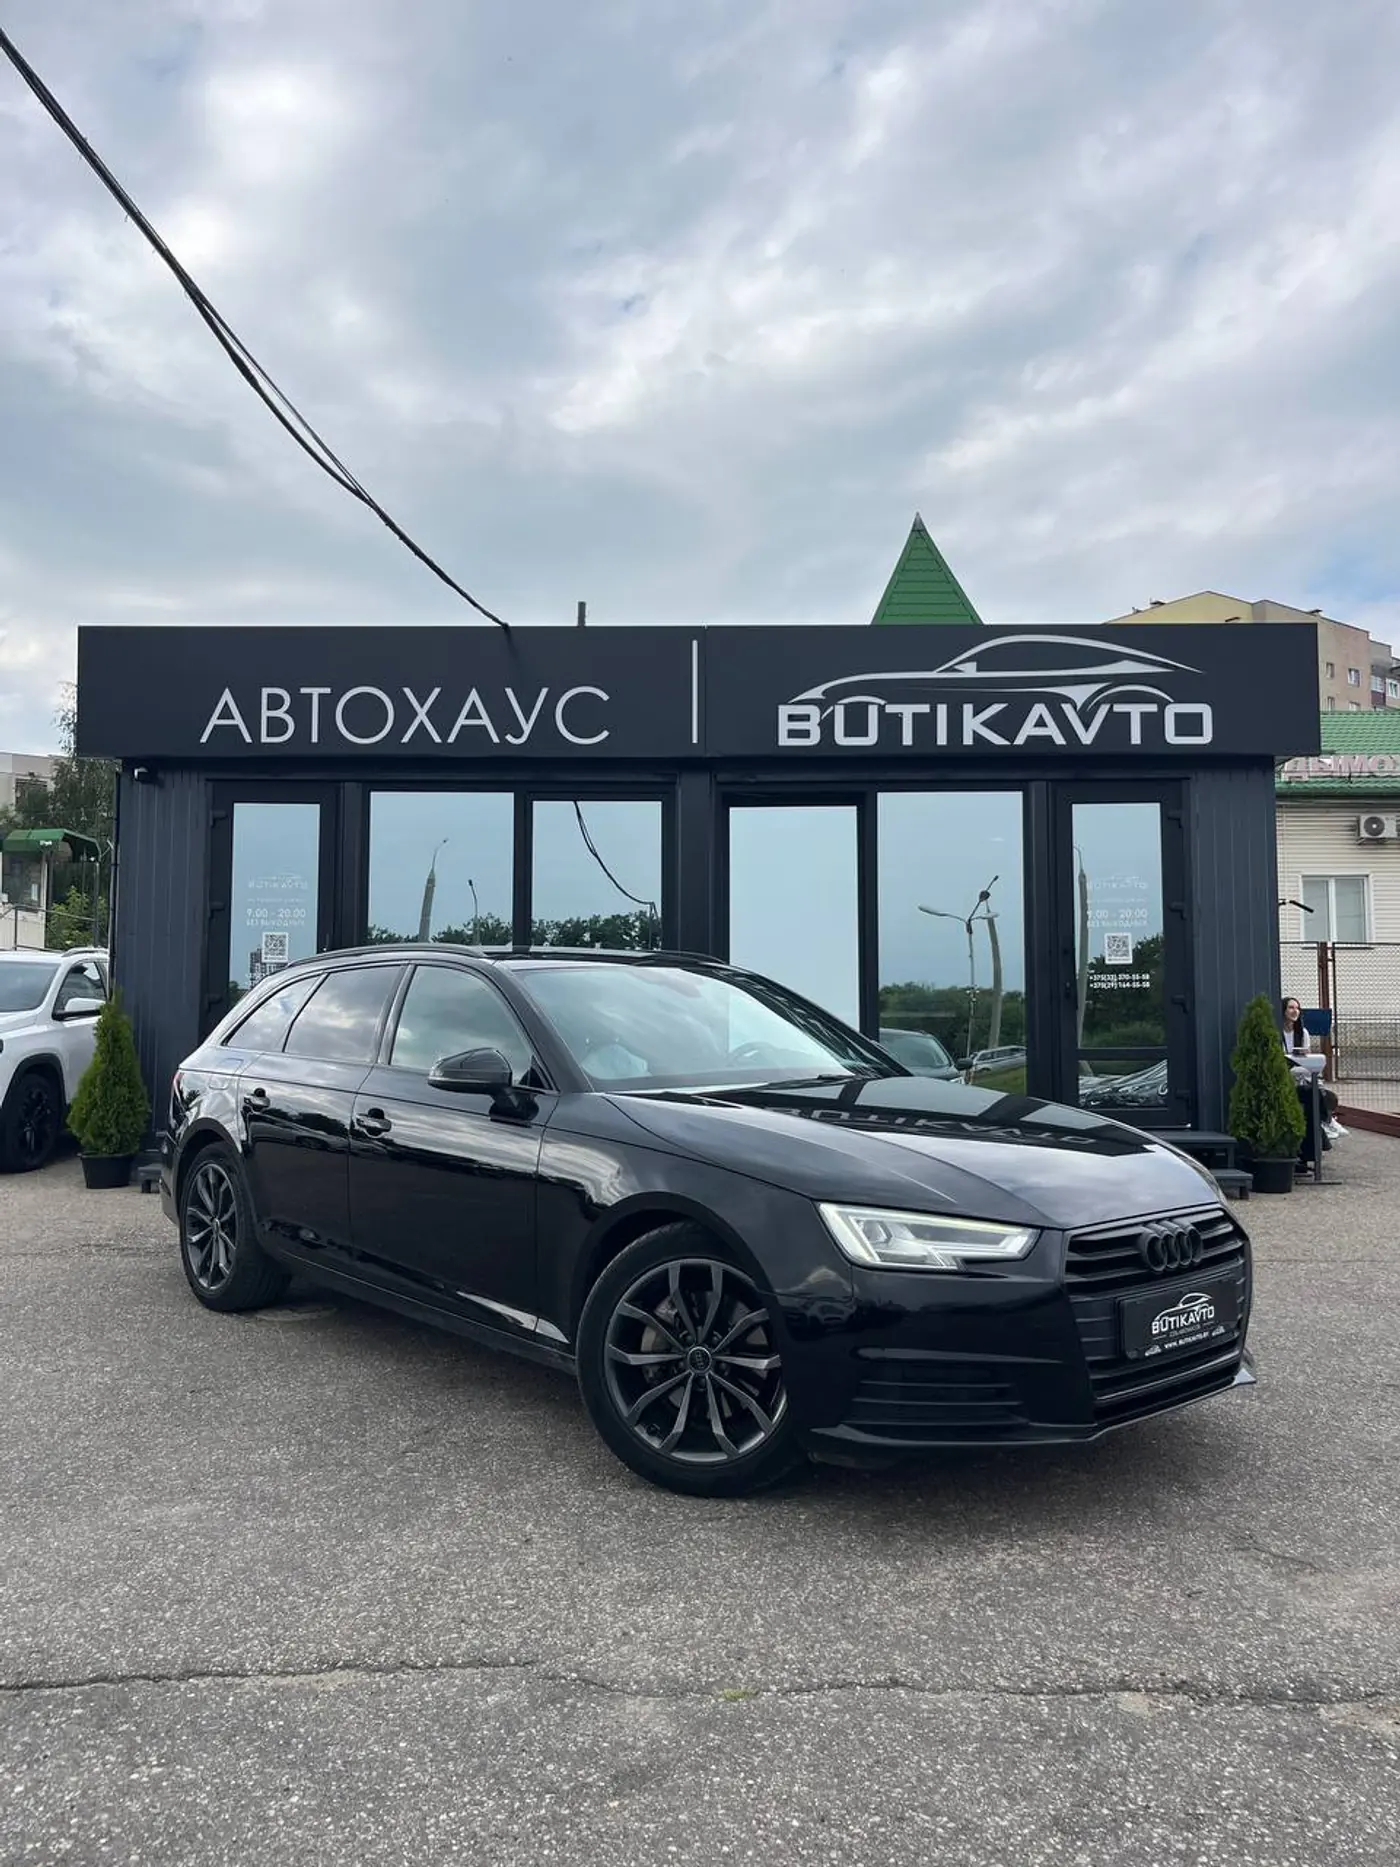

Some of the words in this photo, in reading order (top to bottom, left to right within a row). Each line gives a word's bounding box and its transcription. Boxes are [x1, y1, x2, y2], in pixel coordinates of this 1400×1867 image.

[199, 685, 611, 746] АВТОХАУС
[777, 702, 1214, 747] BUTIKAVTO
[1152, 1306, 1215, 1334] BUTIKAVTO
